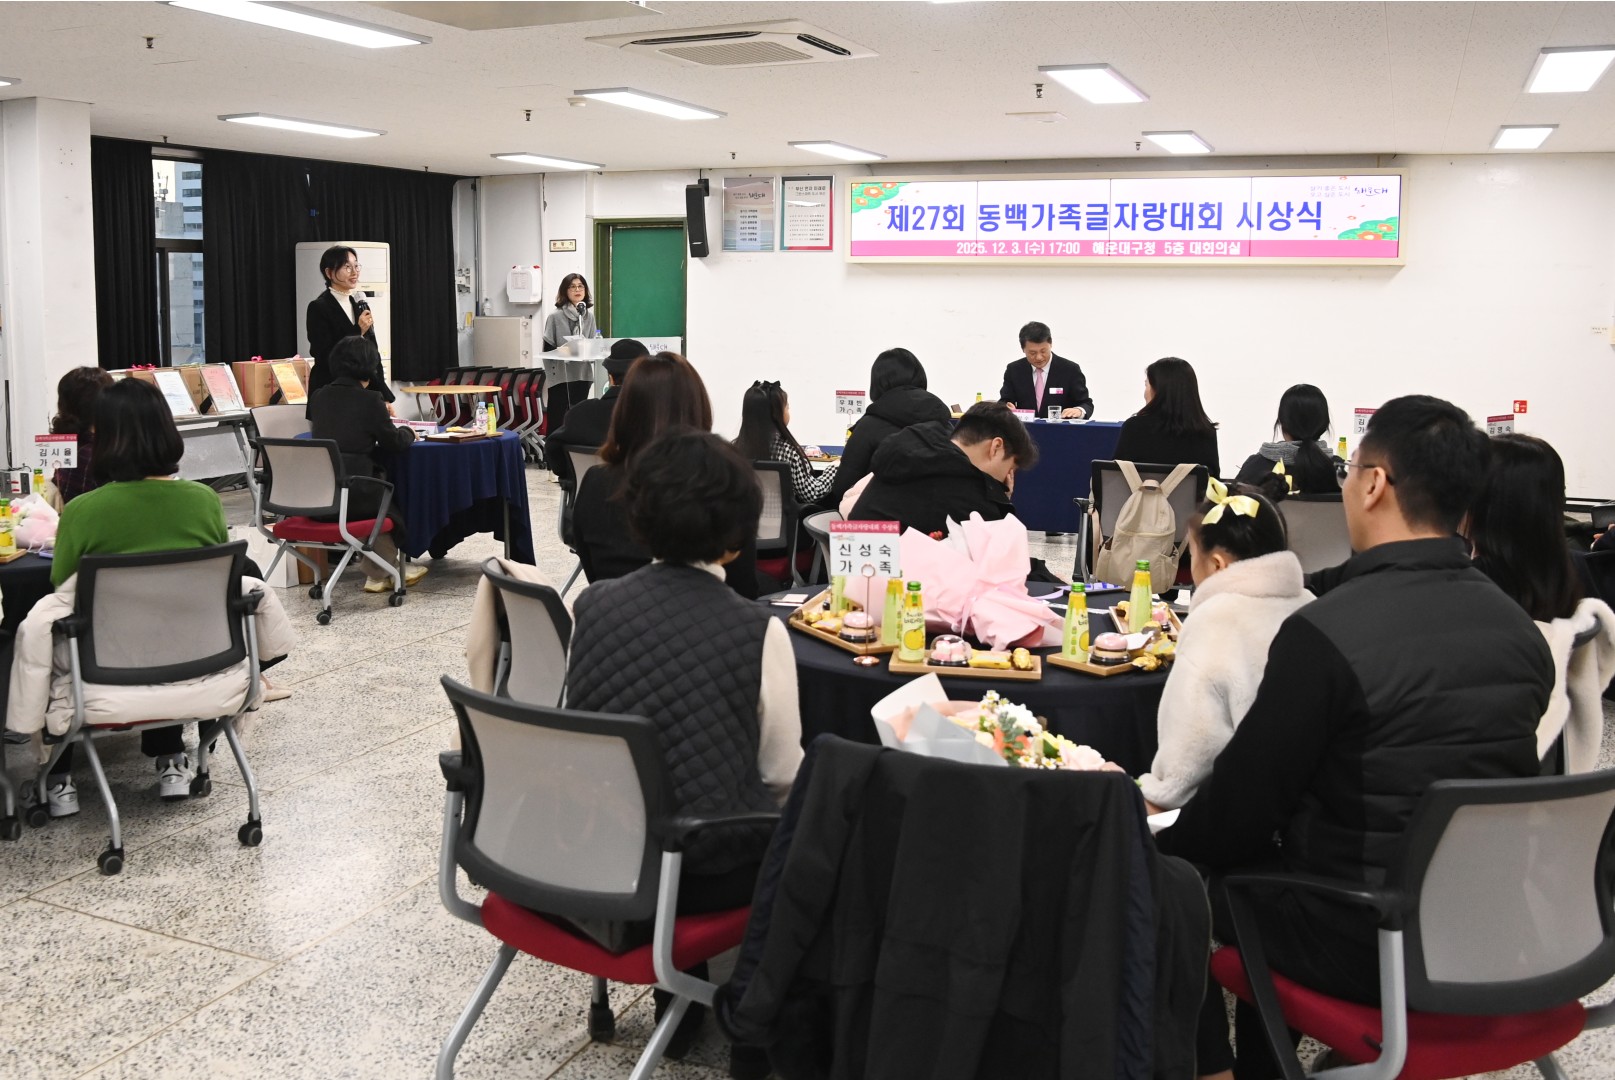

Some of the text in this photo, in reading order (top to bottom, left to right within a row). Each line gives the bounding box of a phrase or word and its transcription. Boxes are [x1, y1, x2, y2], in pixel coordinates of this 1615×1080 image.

[887, 201, 1322, 232] 제27회 동백가족글자랑대회 시상식
[956, 241, 1241, 255] 2025. 12. 3. (수) 17:00 해운대구청 5층 대회의실
[839, 543, 891, 557] 신성숙
[839, 560, 891, 574] 가족
